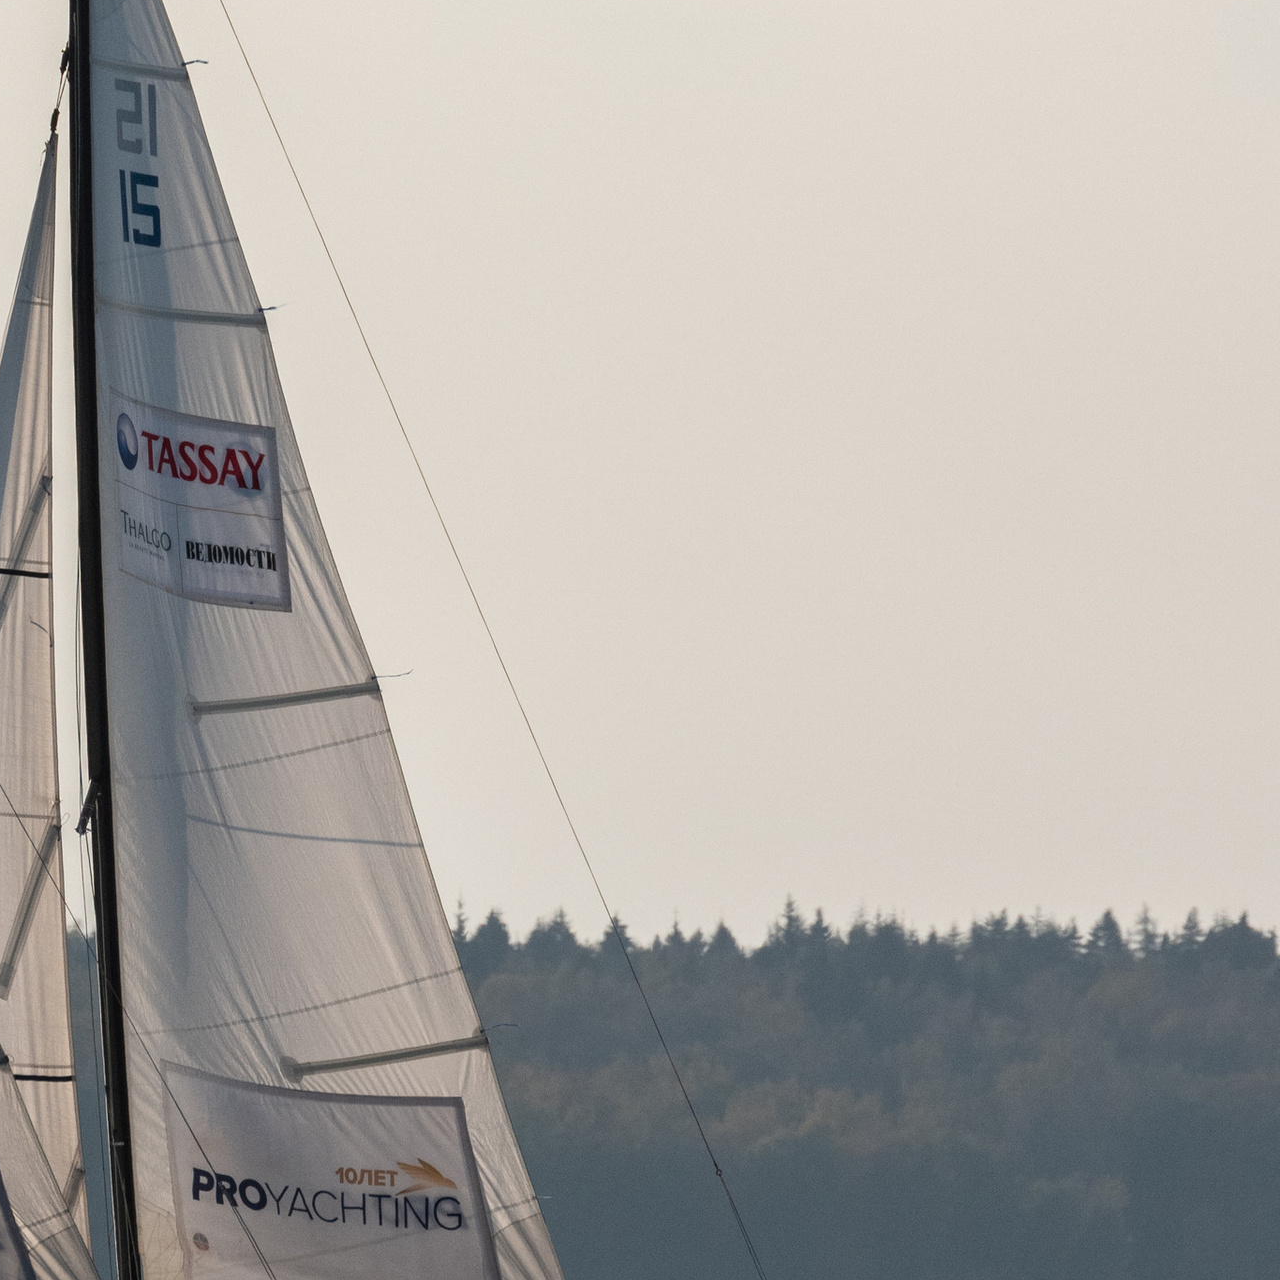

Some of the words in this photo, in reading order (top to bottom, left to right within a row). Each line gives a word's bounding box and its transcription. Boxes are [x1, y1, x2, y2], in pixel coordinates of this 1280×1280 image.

[119, 168, 162, 248] 15
[140, 430, 266, 491] TASSAY
[120, 508, 172, 552] THALGO
[185, 540, 278, 572] ВЕДОМОСТИ
[191, 1167, 463, 1231] PROYACHTING
